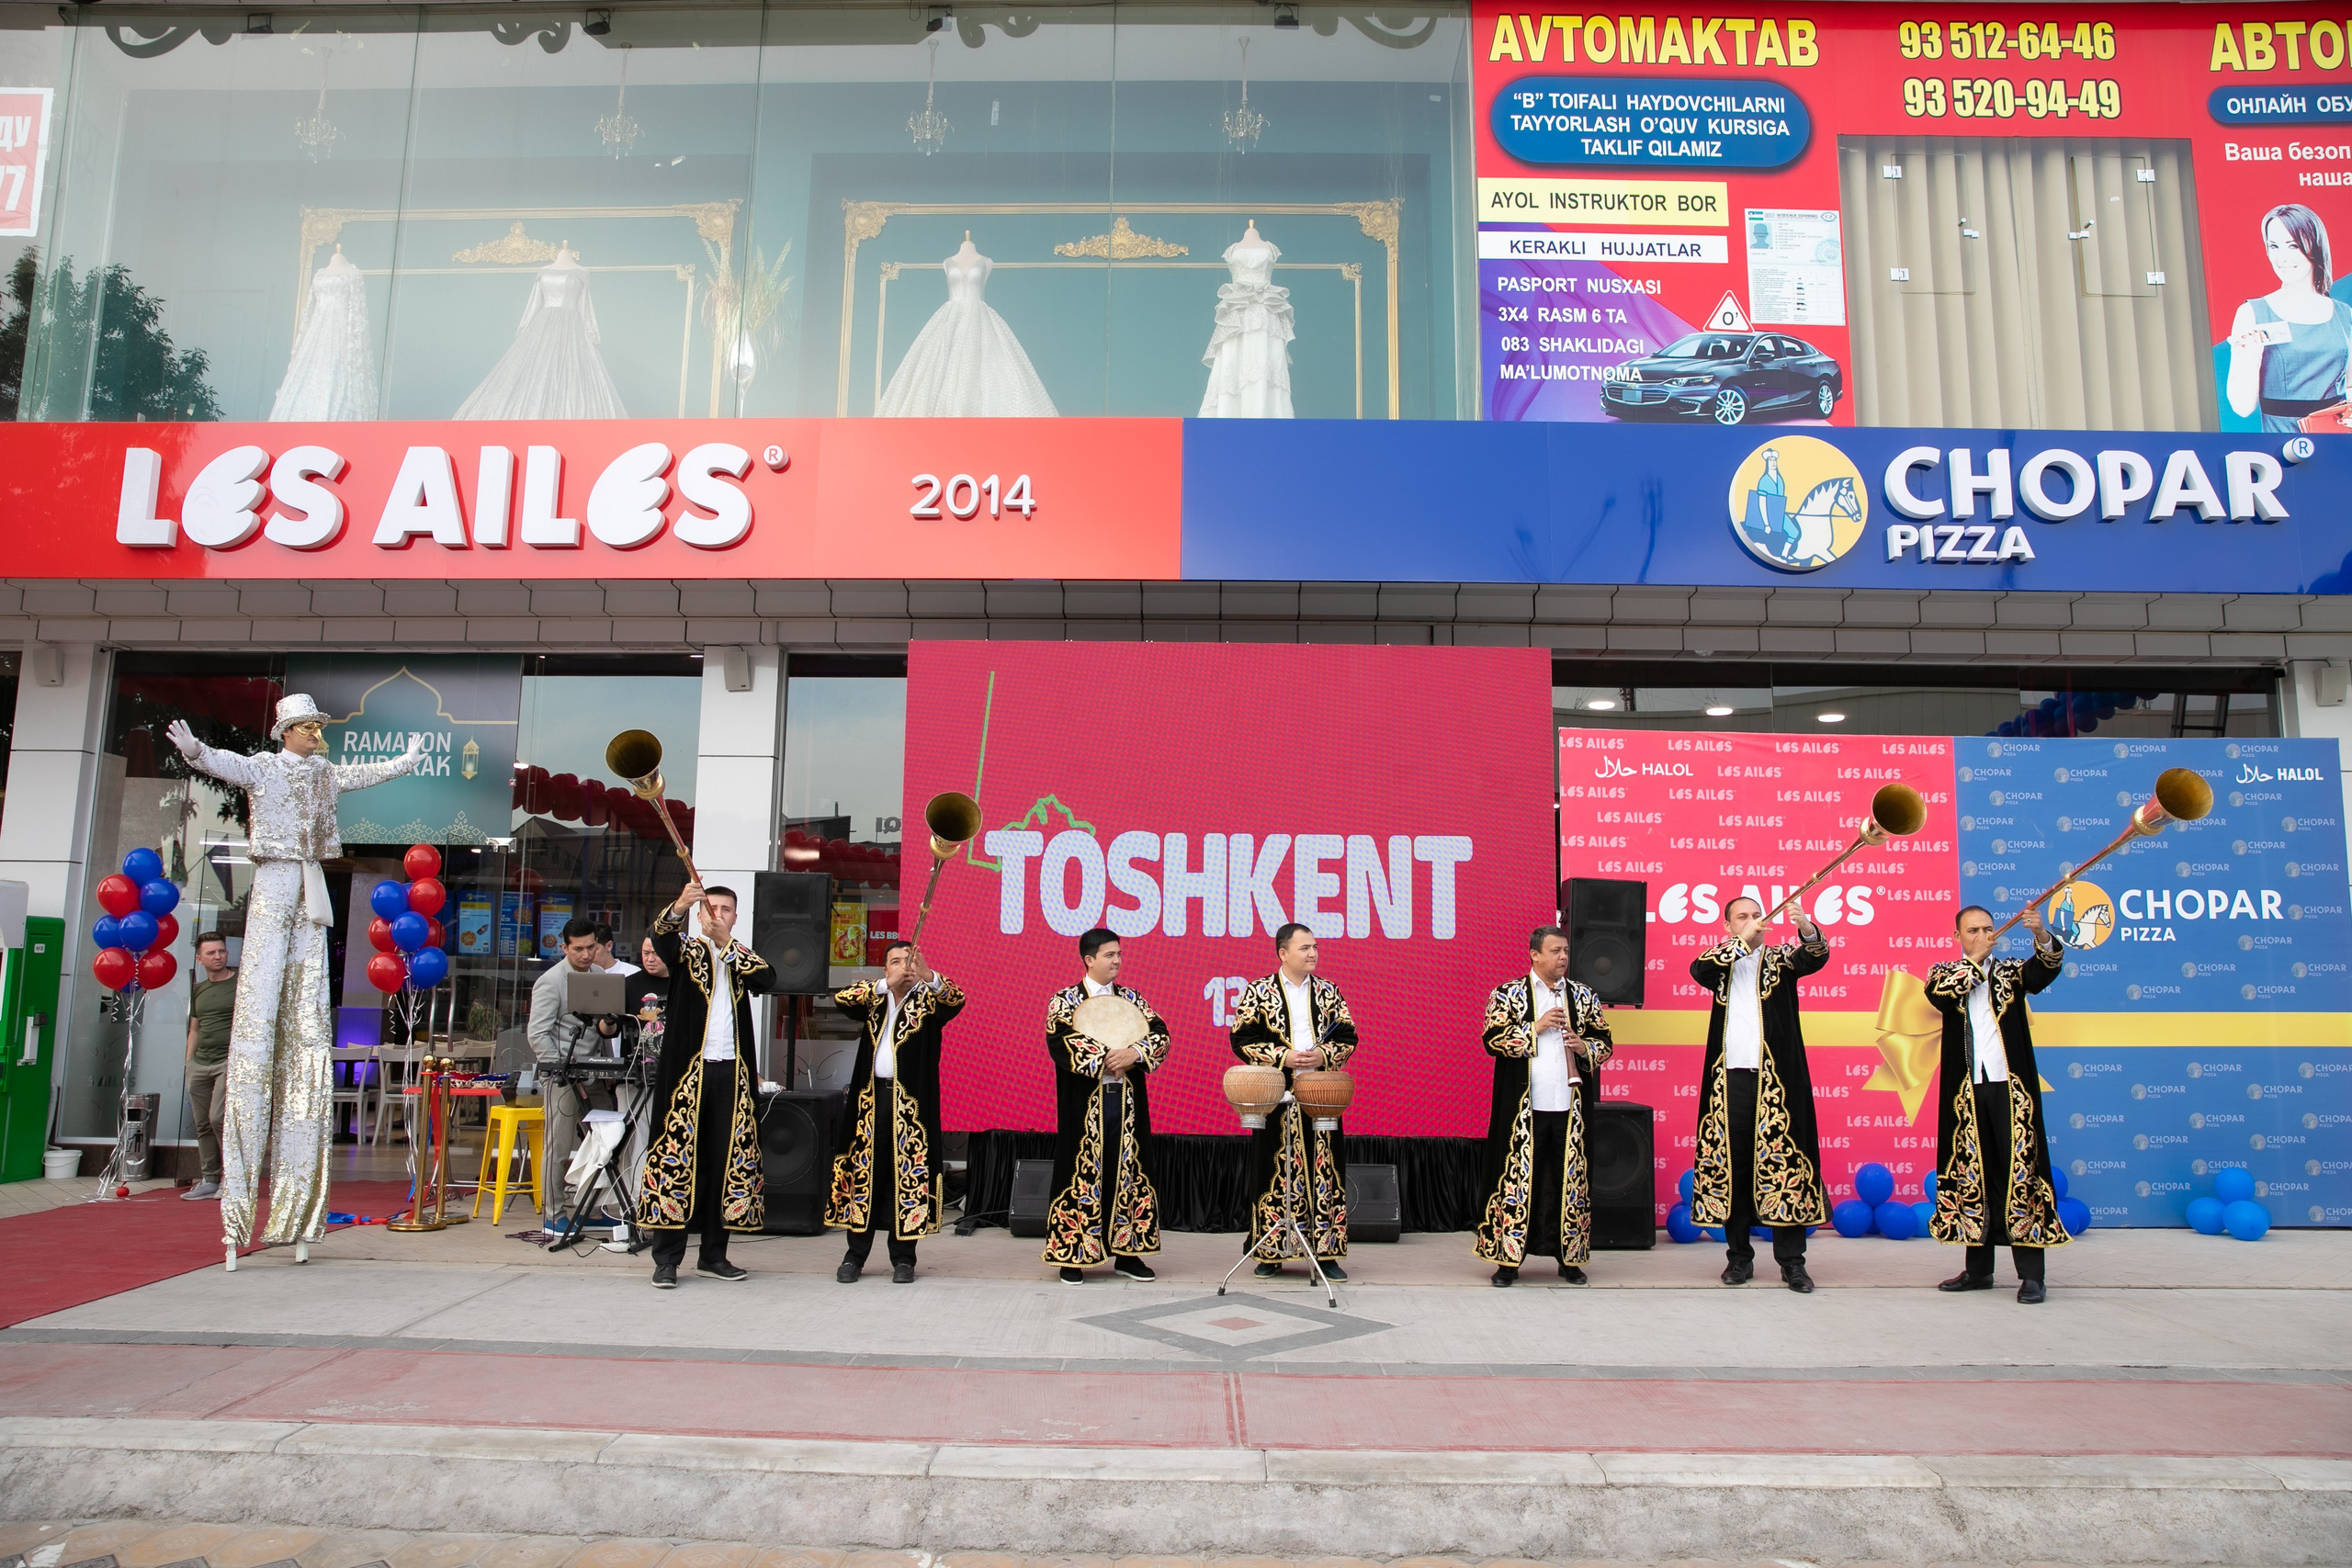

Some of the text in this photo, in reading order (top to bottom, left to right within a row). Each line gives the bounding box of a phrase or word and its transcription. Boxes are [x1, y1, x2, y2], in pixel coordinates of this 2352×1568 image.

[1488, 15, 1819, 67] AVTOMAKTAB
[1899, 21, 2116, 61] 93 512-64-46
[2210, 19, 2352, 72] АВТО
[1549, 94, 1617, 110] TOIFALI
[1627, 96, 1785, 113] HAYDOVCHILARNI
[1903, 77, 2120, 118] 93 520-94-49
[2226, 94, 2306, 114] ОНЛАЙН
[1511, 115, 1630, 133] TAYYORLASH
[1708, 118, 1790, 136] KURSIGA
[1581, 139, 1722, 157] TAKLIF QILAMIZ
[2225, 142, 2350, 161] Ваша безоп
[1491, 192, 1716, 212] AYOL INSTRUKTOR BOR
[1510, 240, 1702, 257] KERAKLI HUJJATLAR
[1498, 277, 1661, 295] PASPORT NUSXASI
[1498, 308, 1627, 324] 3X4 RASM 6 TA
[1501, 337, 1644, 355] 083 SHAKLIDAGI
[1883, 446, 2290, 521] CHOPAR
[116, 442, 754, 549] LES AILES
[910, 474, 1036, 519] 2014
[1887, 525, 2036, 564] PIZZA
[1560, 737, 1624, 750] LES AILES
[1668, 739, 1732, 751] LES AILES
[1776, 742, 1839, 753] LES AILES
[1883, 744, 1945, 754] LES AILES
[1643, 763, 1693, 776] HALOL
[1718, 766, 1781, 777] LES AILES
[1838, 768, 1901, 779] LES AILES
[2277, 768, 2324, 781] HALOL
[1561, 786, 1625, 798] LES AILES
[1669, 788, 1734, 800] LES AILES
[1778, 791, 1841, 802] LES AILES
[1598, 812, 1662, 824] LES AILES
[1719, 816, 1783, 827] LES AILES
[1562, 836, 1626, 848] LES AILES
[1670, 838, 1735, 850] LES AILES
[1779, 840, 1842, 851] LES AILES
[1886, 840, 1949, 852] LES AILES
[1599, 862, 1663, 873] LES AILES
[1720, 865, 1784, 876] LES AILES
[1841, 863, 1905, 874] LES AILES
[984, 829, 1473, 941] TOSHKENT
[1888, 890, 1951, 901] LES AILES
[2120, 889, 2284, 919] CHOPAR
[869, 931, 899, 940] LES BB
[1672, 935, 1695, 945] LES
[2120, 927, 2177, 942] PIZZA
[1889, 937, 1953, 948] LES AILES
[1844, 964, 1866, 975] LES
[1673, 985, 1696, 996] LES
[1809, 986, 1847, 997] AILES
[2143, 986, 2180, 994] CHOPAR
[2257, 986, 2295, 994] CHOPAR
[1627, 1060, 1666, 1071] AILES
[1895, 1184, 1918, 1195] LES
